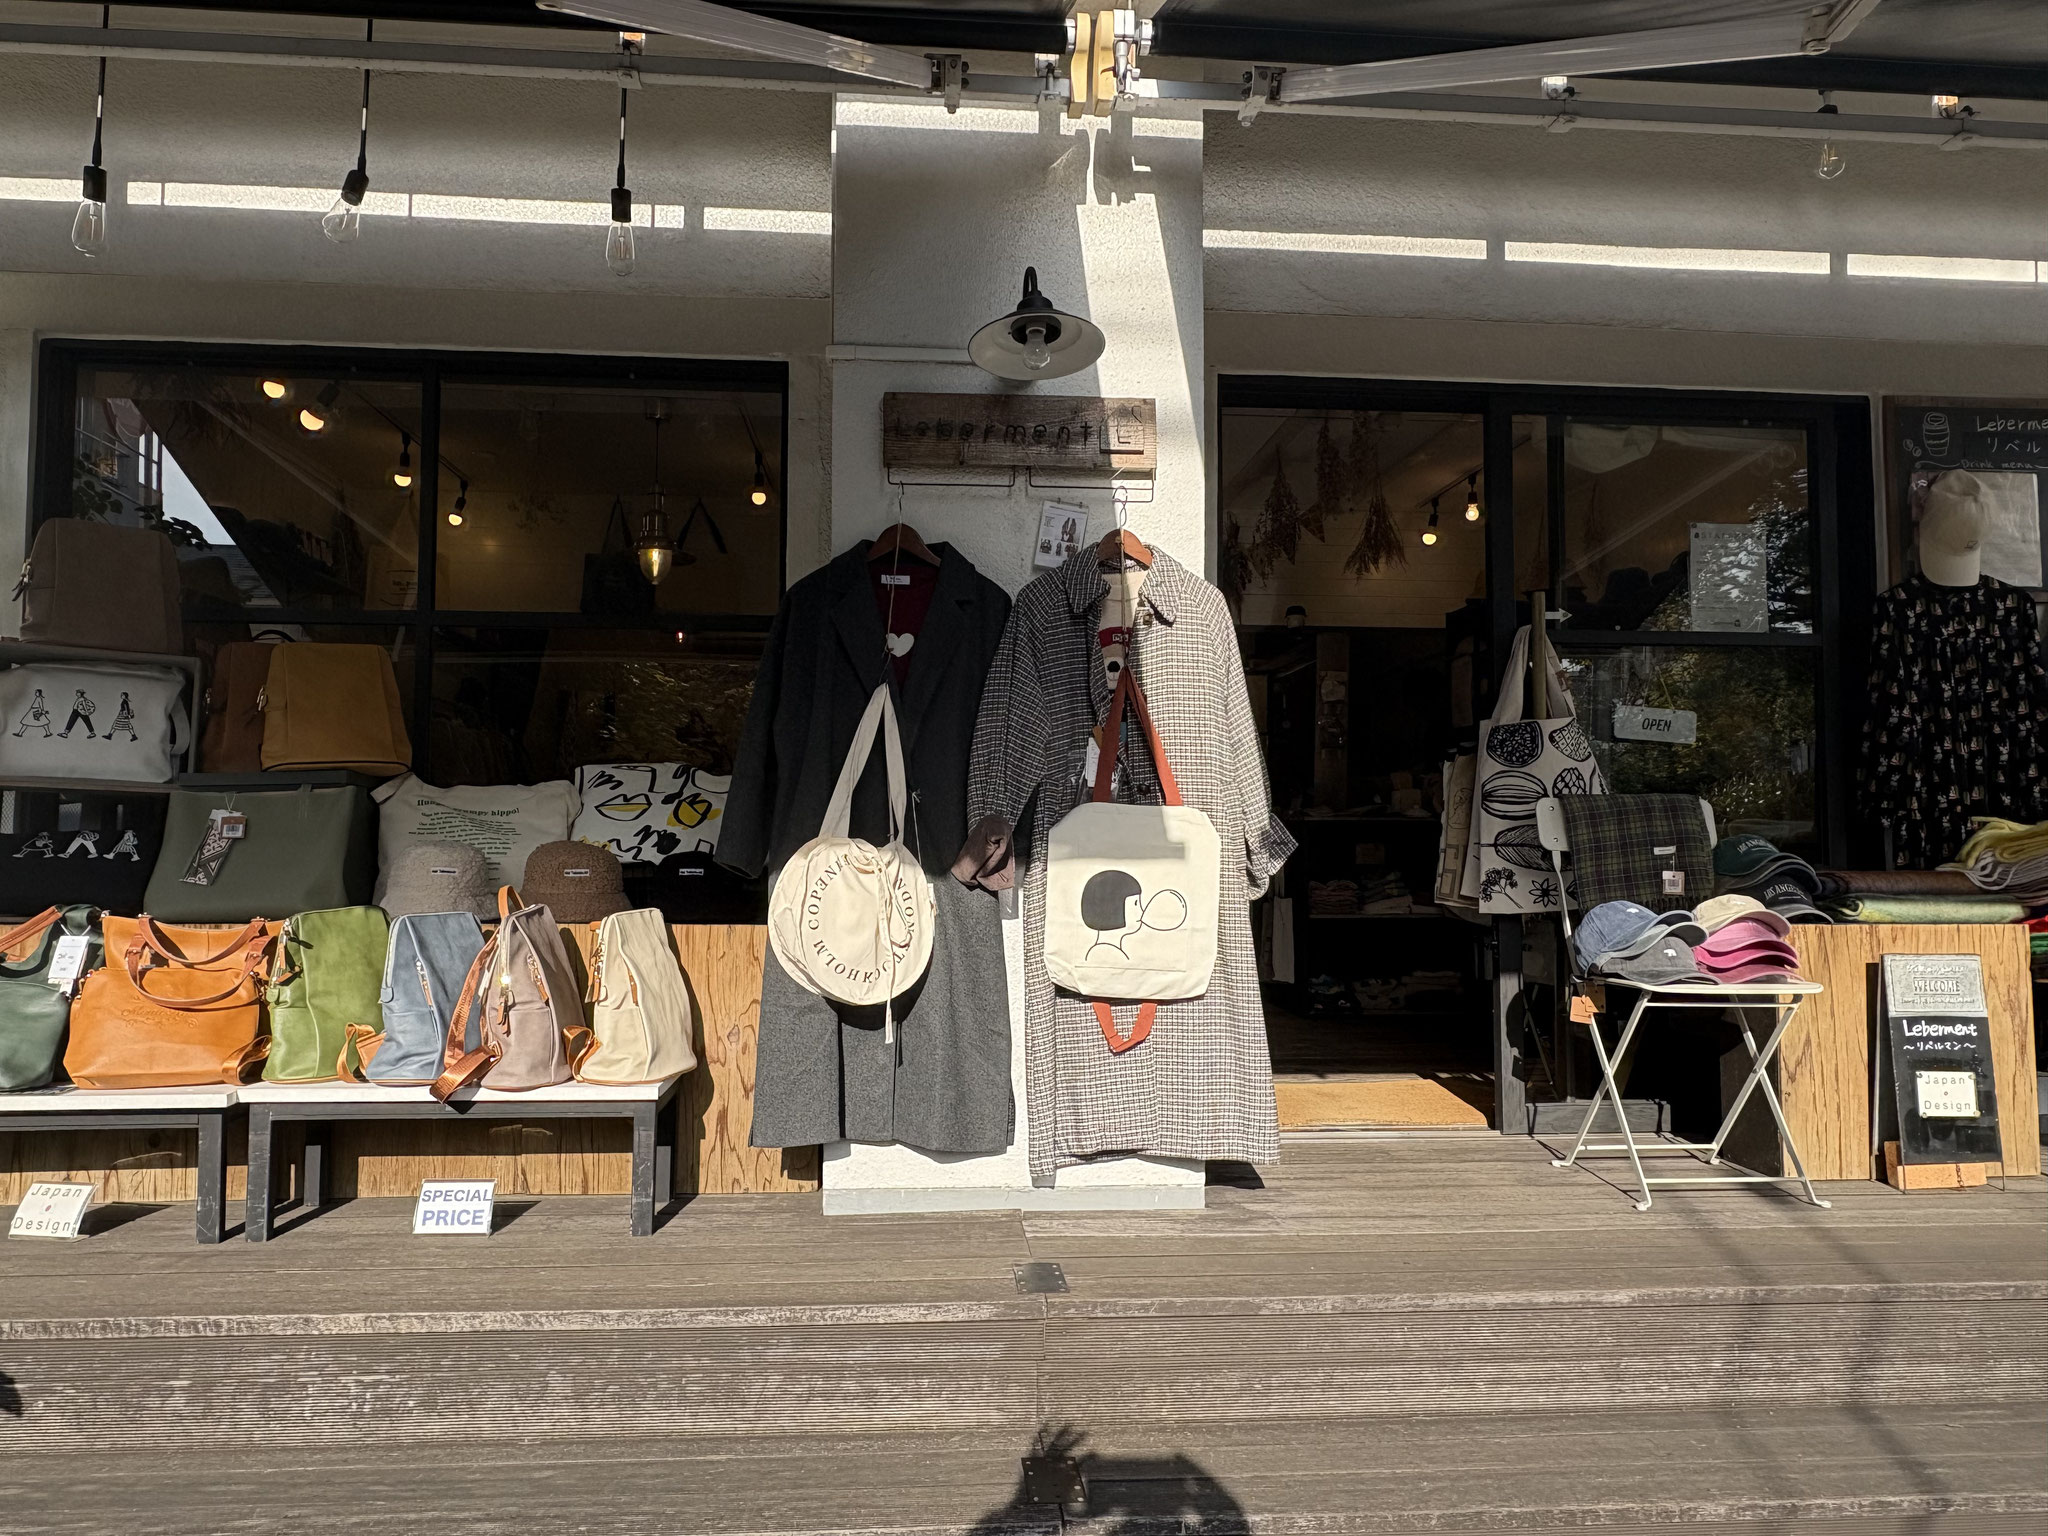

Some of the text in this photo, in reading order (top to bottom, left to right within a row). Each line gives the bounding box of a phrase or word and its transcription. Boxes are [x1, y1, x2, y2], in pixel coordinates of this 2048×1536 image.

[1961, 459, 2033, 469] Drink menu
[1642, 718, 1672, 732] OPEN
[1914, 980, 1960, 993] WELCOME
[1902, 1019, 1978, 1037] Leberment
[1925, 1075, 1965, 1087] Japan
[1924, 1100, 1971, 1112] Design
[31, 1185, 82, 1199] Japan
[421, 1189, 493, 1202] SPECIAL
[421, 1209, 485, 1226] PRICE
[13, 1216, 71, 1234] Design
